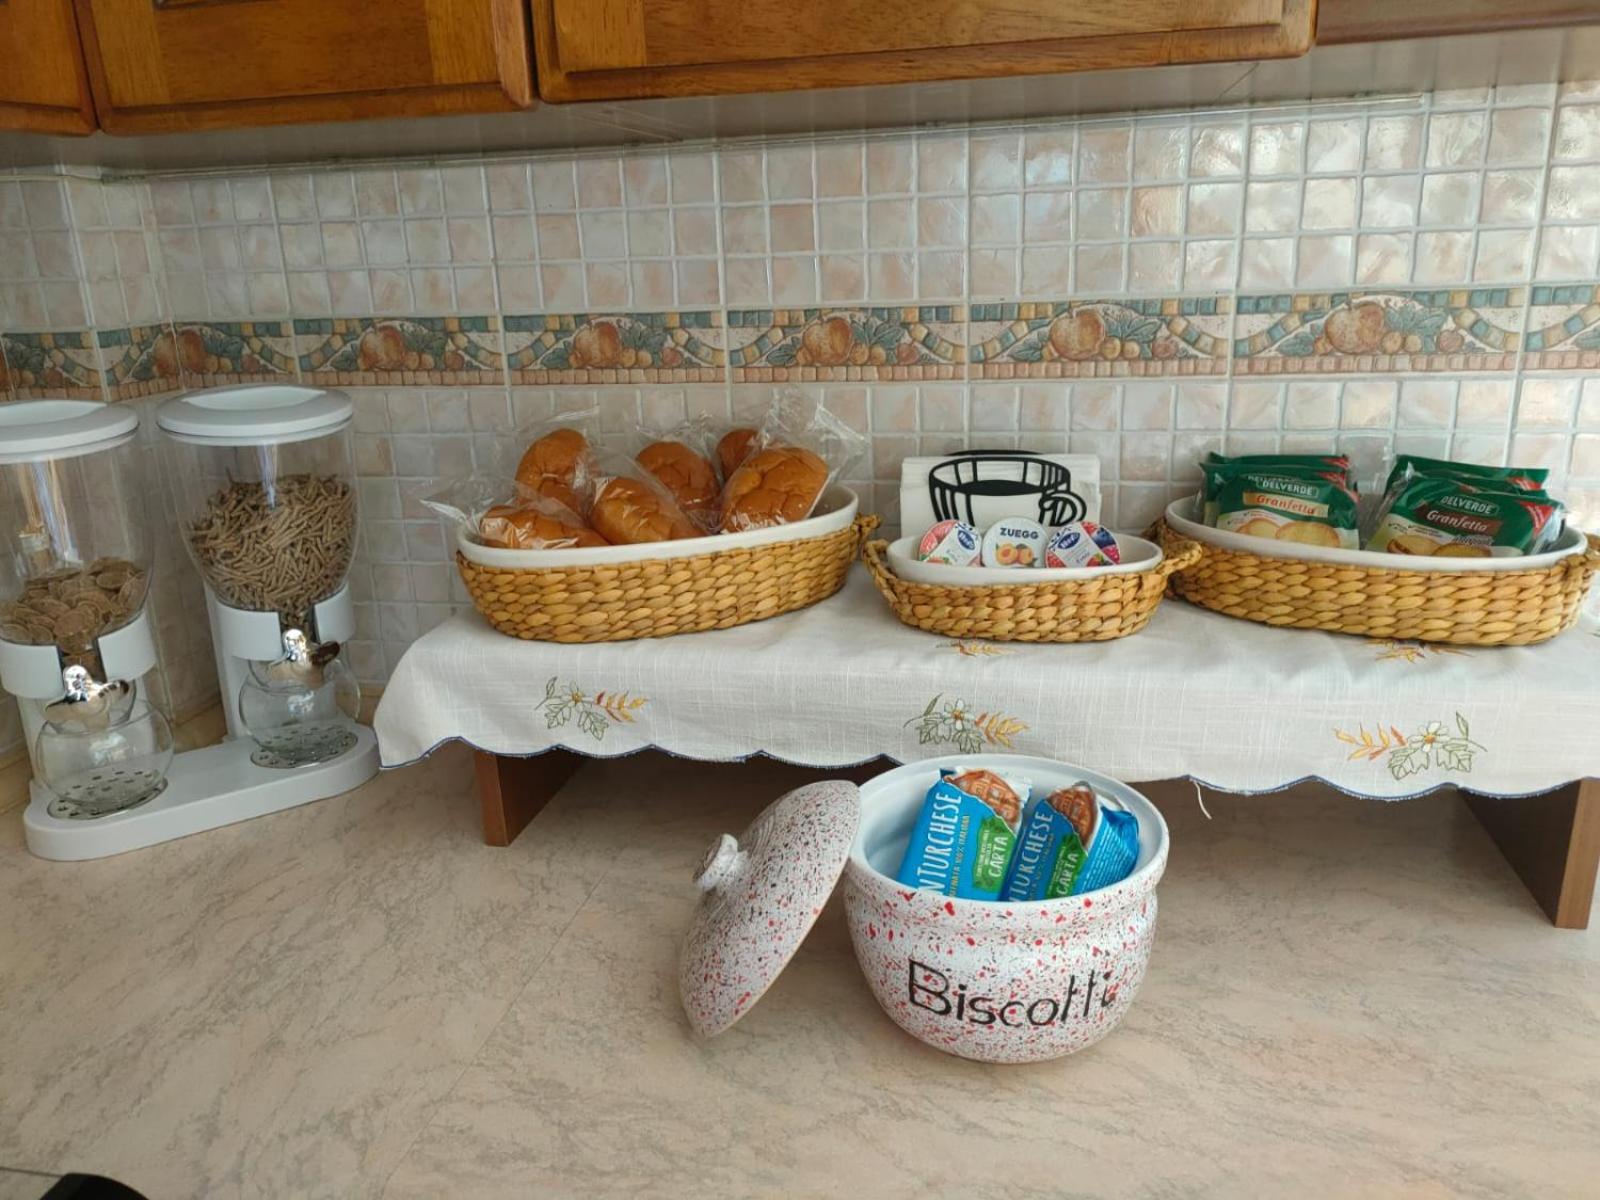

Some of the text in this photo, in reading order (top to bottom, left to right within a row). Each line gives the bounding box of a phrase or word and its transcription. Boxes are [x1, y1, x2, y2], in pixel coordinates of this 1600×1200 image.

[1262, 479, 1314, 497] DELVERDE
[1256, 494, 1317, 515] Granfetta
[1441, 495, 1493, 514] DELVERDE
[1427, 510, 1488, 533] Granfetta
[1000, 527, 1039, 540] ZUEGG
[988, 836, 1009, 878] CARTA
[1056, 852, 1080, 896] CARTA
[908, 958, 1116, 1027] Biscotti
